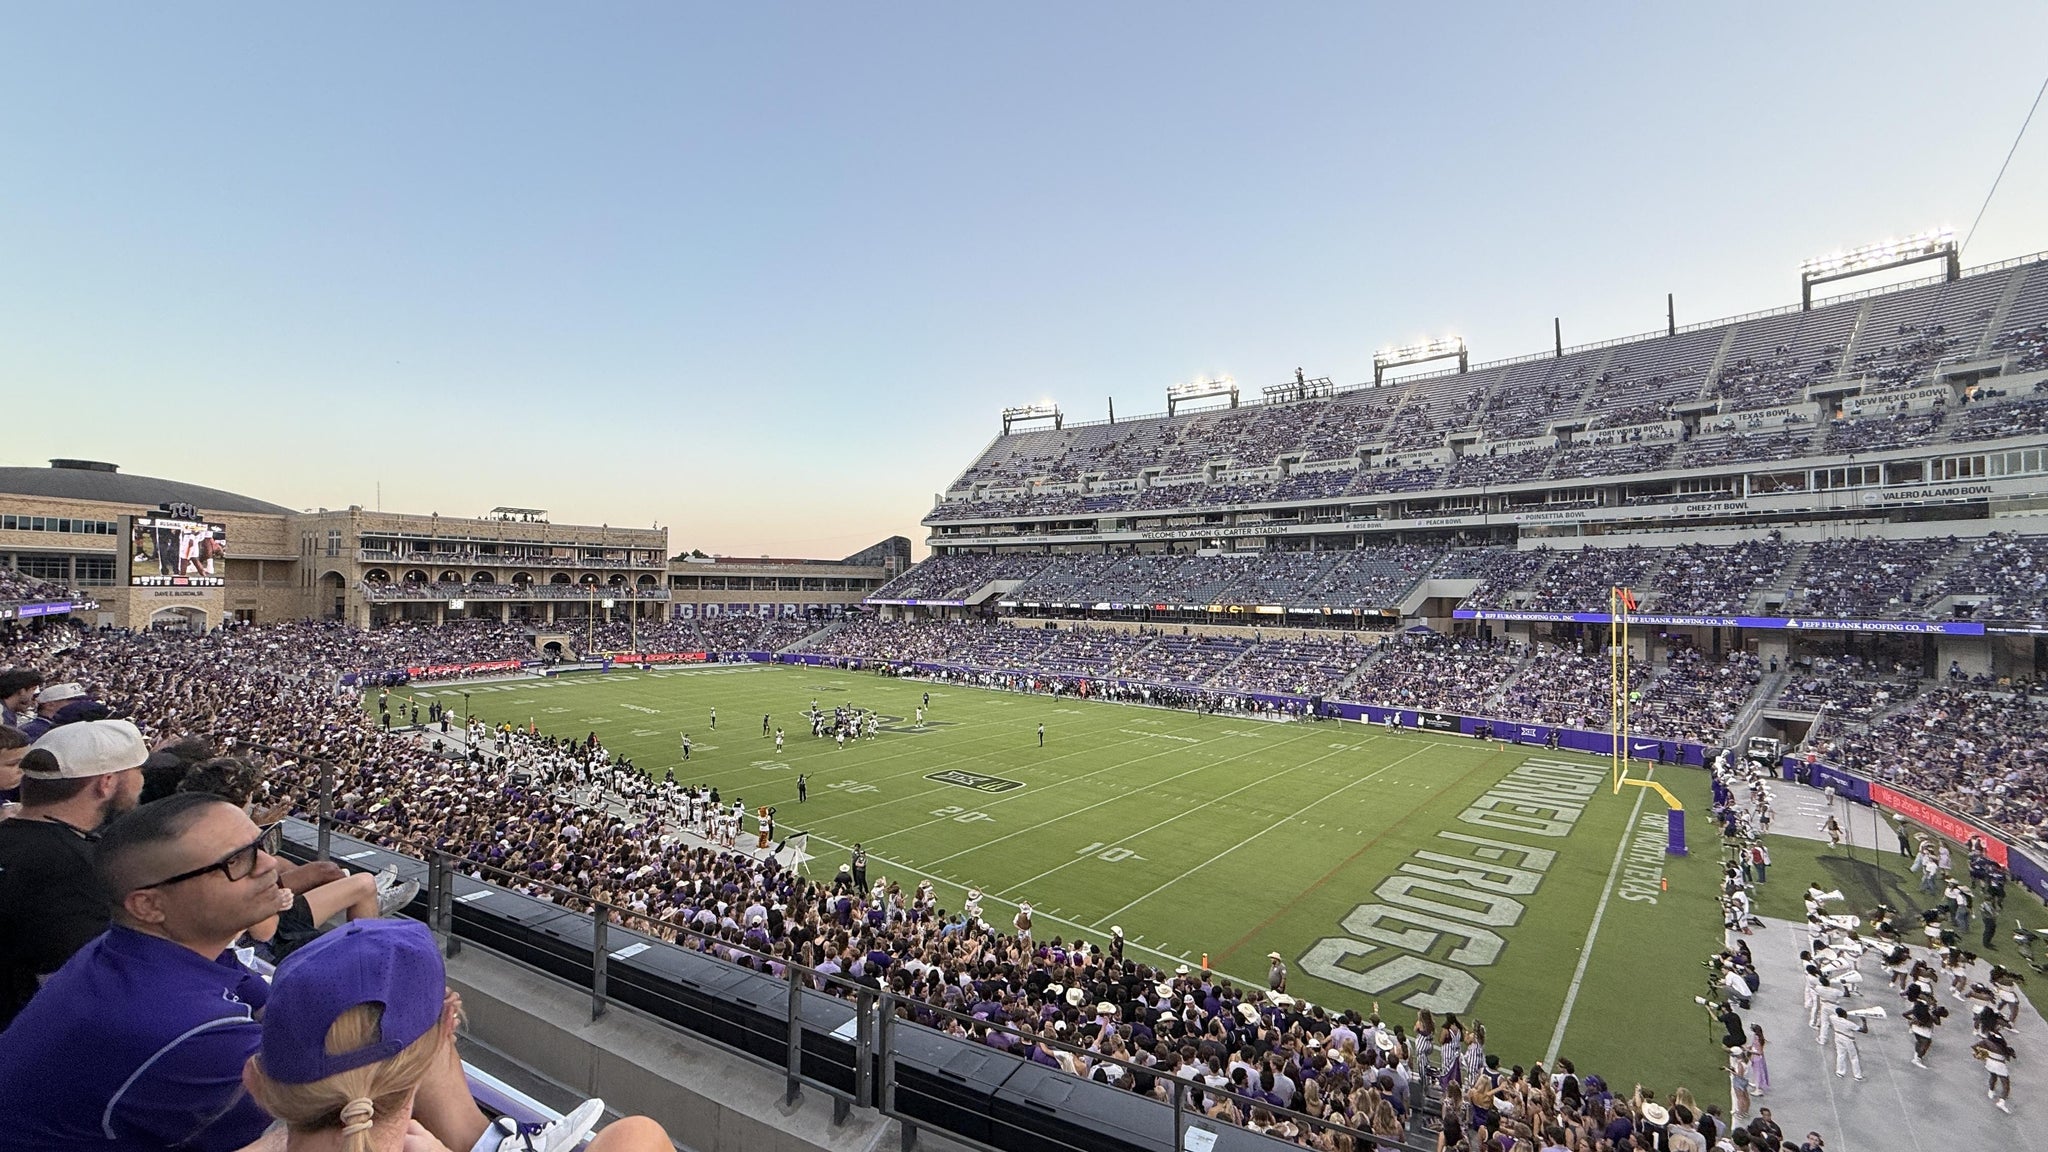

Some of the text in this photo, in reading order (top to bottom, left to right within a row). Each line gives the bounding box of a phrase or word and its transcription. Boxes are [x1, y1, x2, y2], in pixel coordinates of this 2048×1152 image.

[1855, 387, 1949, 408] NEW MEXICO BOWL
[1738, 408, 1791, 420] TEXAS BOWL
[1882, 485, 1994, 500] VALERO ALAMO BOWL
[169, 502, 198, 520] TCU
[1686, 502, 1749, 512] CHEEZ-IT BOWL
[1525, 512, 1563, 520] POINSETTIA
[1142, 531, 1175, 539] WELCOME
[1178, 530, 1188, 538] TO
[1224, 528, 1252, 536] CARTER
[1254, 526, 1288, 535] STADIUM
[1672, 617, 1704, 625] ROOFING
[1801, 621, 1820, 629] JEFF
[1822, 621, 1861, 629] EUBANK
[1862, 622, 1904, 631] ROOFING
[1926, 624, 1946, 632] INC.
[827, 779, 876, 794] 30
[1455, 757, 1611, 838] HORNED
[928, 805, 989, 823] 20
[1075, 842, 1135, 862] 10
[1617, 866, 1662, 905] TEXAS
[1297, 829, 1559, 1015] FROGS
